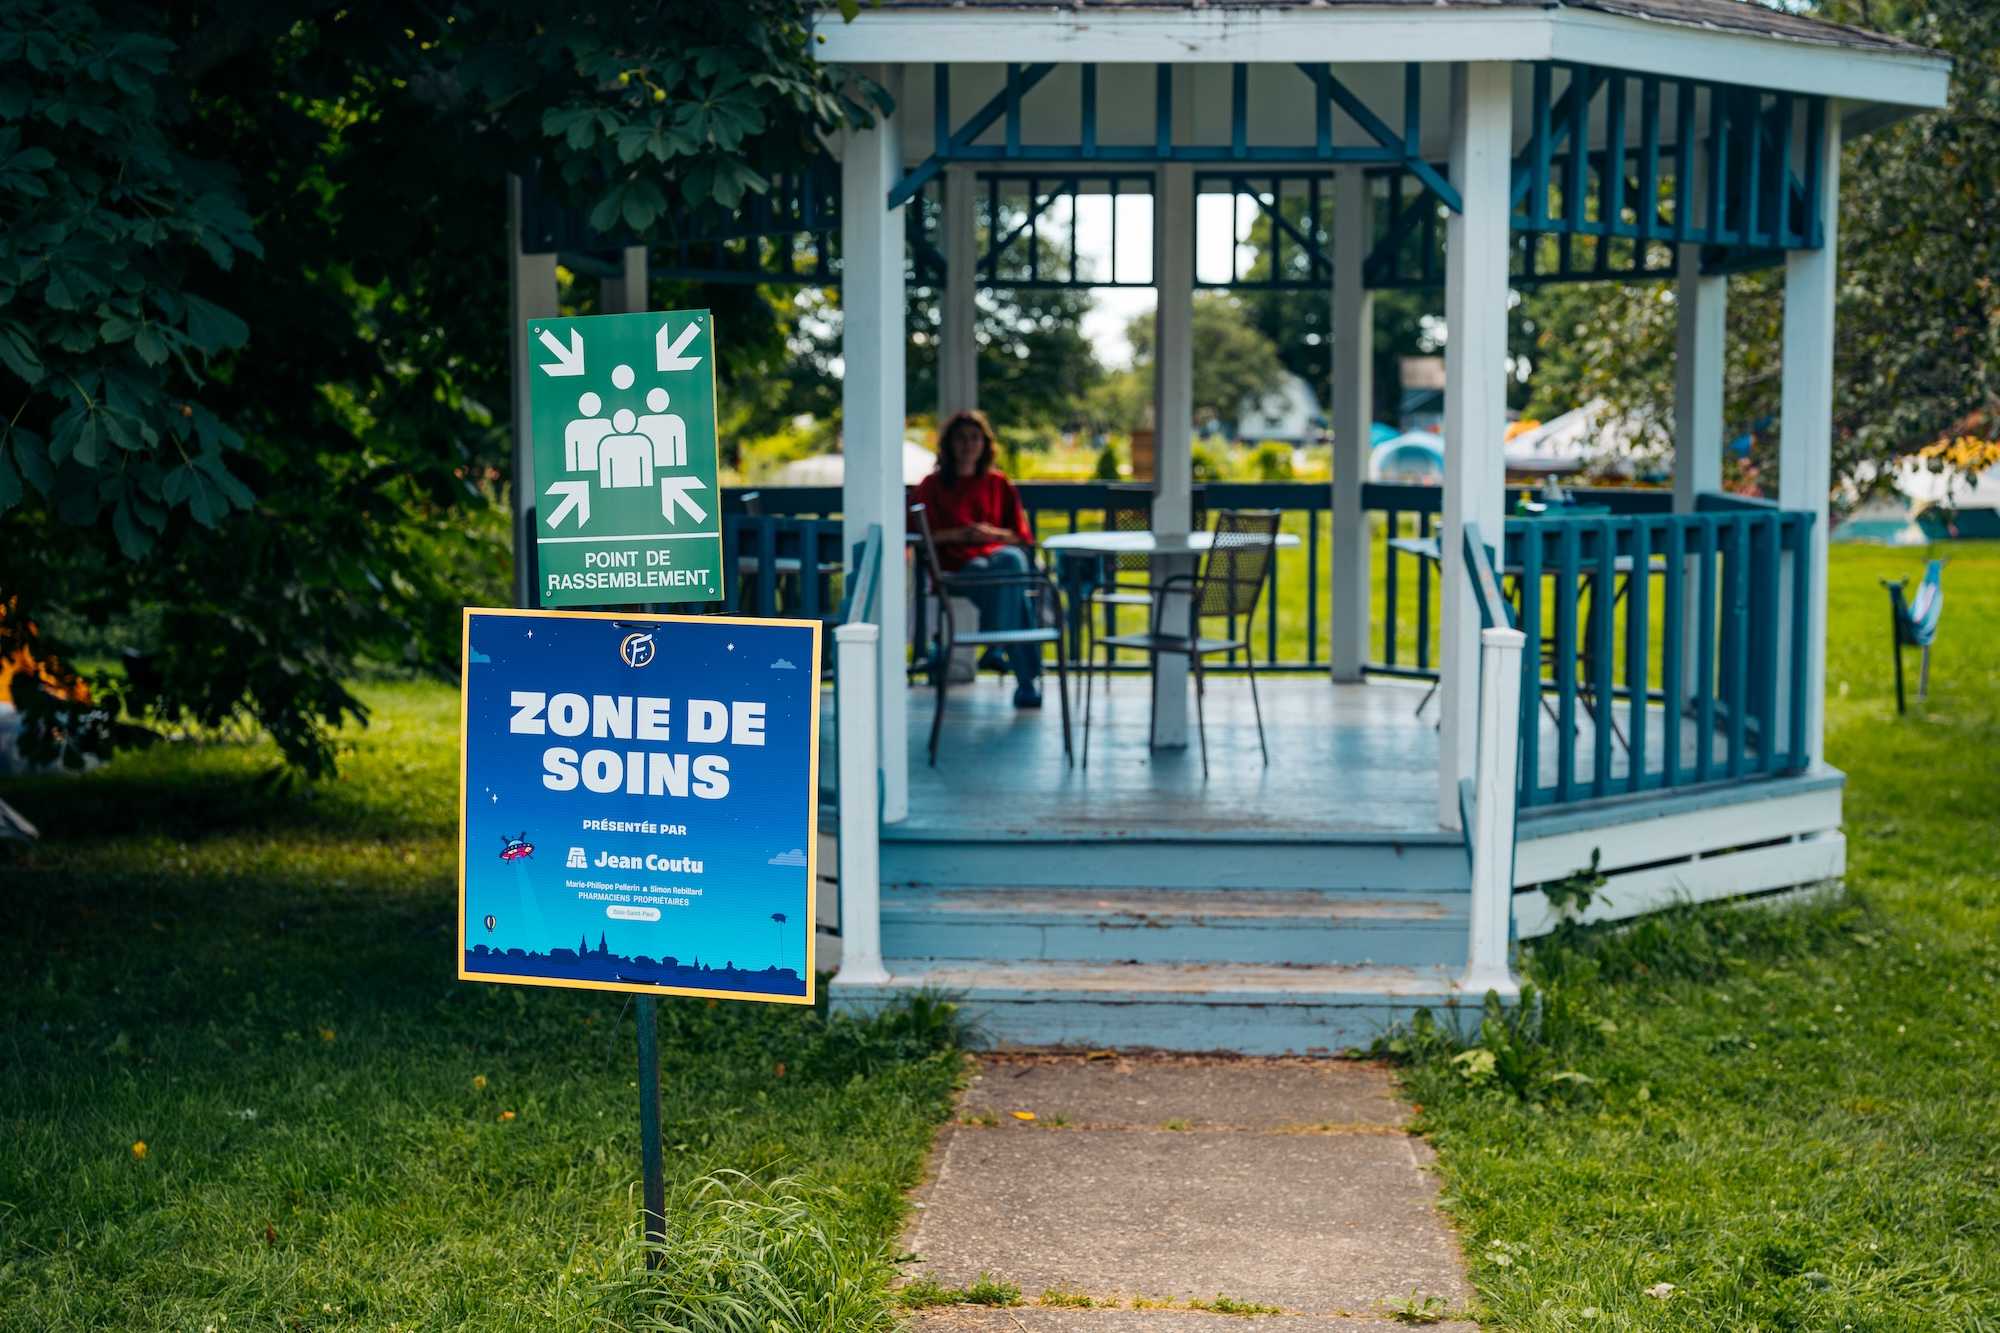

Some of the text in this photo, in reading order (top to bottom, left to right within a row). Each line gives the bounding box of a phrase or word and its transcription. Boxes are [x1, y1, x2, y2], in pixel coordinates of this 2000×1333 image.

[585, 550, 671, 568] POINT DE
[548, 569, 709, 590] RASSEMBLEMENT
[510, 691, 766, 746] ZONE DE
[542, 747, 730, 800] SOINS
[583, 818, 687, 836] PRÉSENTÉE PAR
[594, 851, 643, 870] Jean
[645, 854, 704, 874] Coutu
[578, 891, 690, 906] PHARMACIENS PROPRIÉTAIRES
[650, 885, 671, 894] Simon
